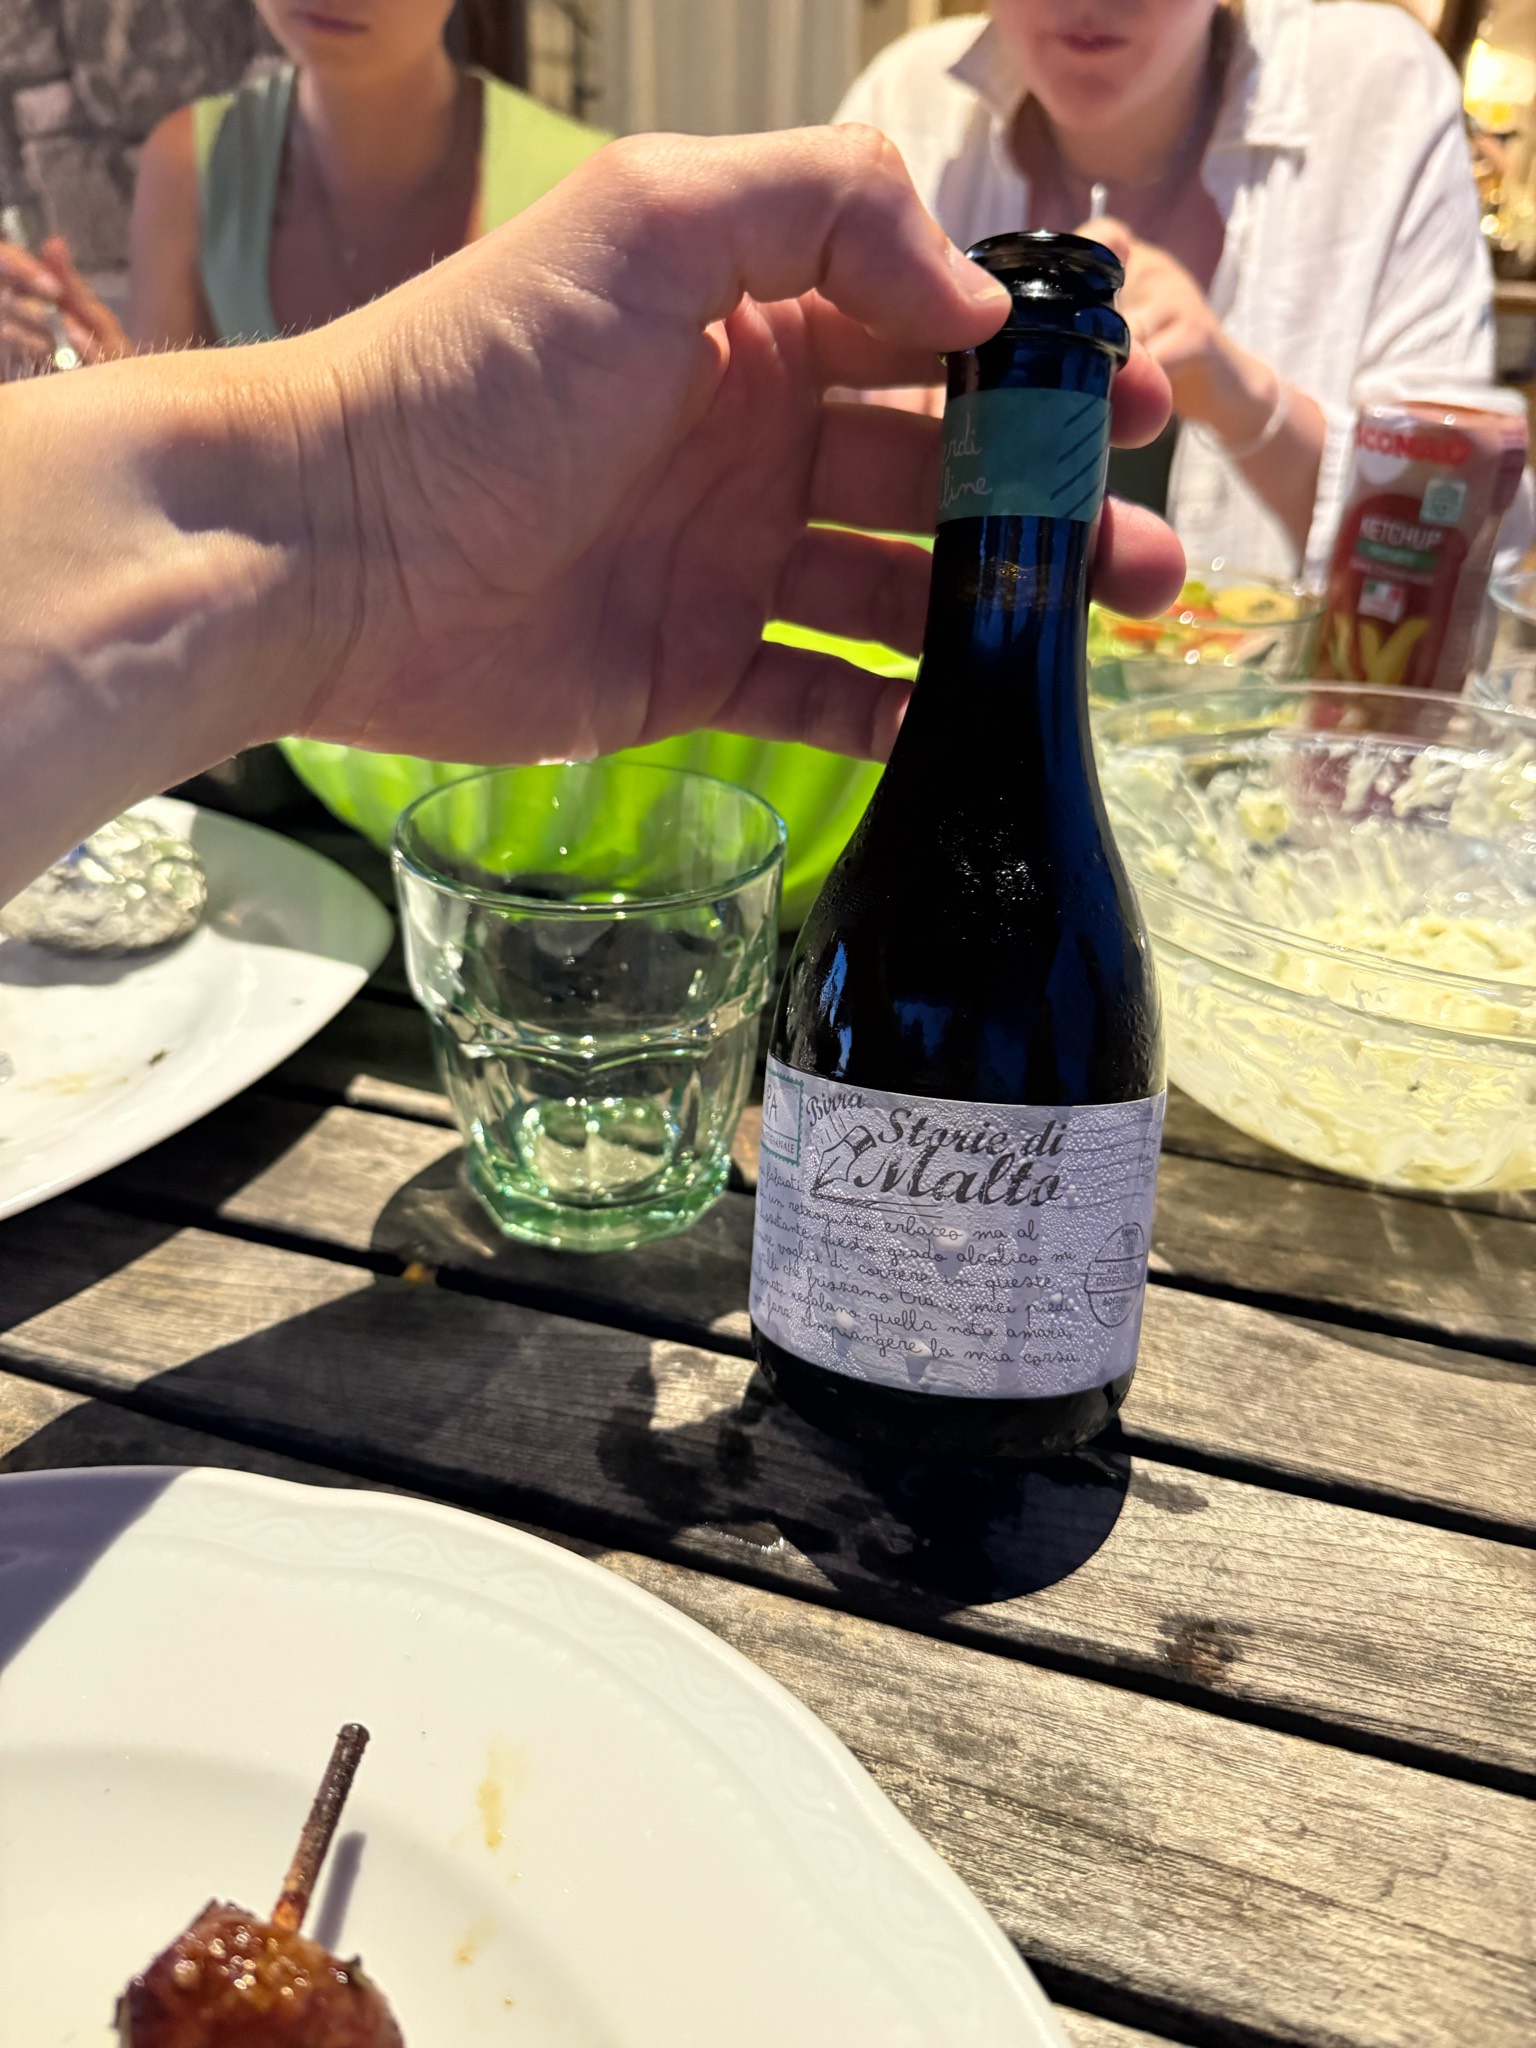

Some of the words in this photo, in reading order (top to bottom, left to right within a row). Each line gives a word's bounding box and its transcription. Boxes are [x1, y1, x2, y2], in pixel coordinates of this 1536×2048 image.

[1360, 517, 1442, 549] KETCHUP
[805, 1091, 865, 1127] Birra
[878, 1108, 1008, 1155] Storie
[1021, 1119, 1068, 1157] di
[854, 1144, 1063, 1207] Malto
[788, 1202, 876, 1237] retrogusto
[885, 1216, 962, 1240] erbaceo
[973, 1228, 1008, 1239] ma
[1017, 1219, 1038, 1241] al
[777, 1239, 823, 1270] voglia
[830, 1250, 849, 1270] di
[857, 1264, 934, 1284] correre
[944, 1274, 976, 1287] in
[985, 1275, 1055, 1301] queste
[821, 1236, 876, 1258] questo
[888, 1238, 947, 1267] grado
[957, 1244, 1041, 1265] alcolico
[1051, 1247, 1076, 1262] mi
[791, 1292, 861, 1322] regalano
[869, 1308, 937, 1335] quella
[947, 1321, 994, 1337] nota
[806, 1267, 893, 1303] frizzano
[899, 1290, 938, 1307] tra
[970, 1302, 1016, 1313] miei
[1025, 1291, 1075, 1327] piedi
[801, 1316, 923, 1357] rimpiangere
[930, 1338, 955, 1358] la
[964, 1349, 1014, 1363] mia
[1023, 1352, 1081, 1367] corsa.
